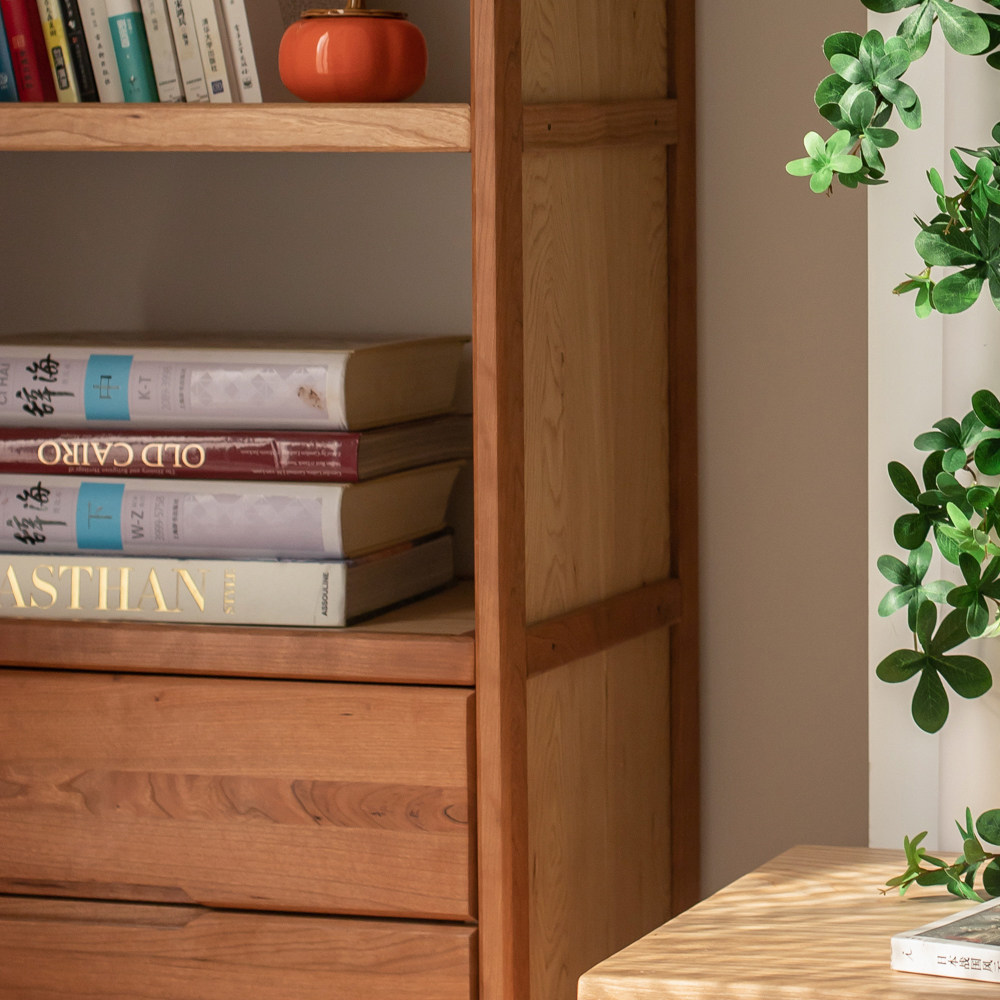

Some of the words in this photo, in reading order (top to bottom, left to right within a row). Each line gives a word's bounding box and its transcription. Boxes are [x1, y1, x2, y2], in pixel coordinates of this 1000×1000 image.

[92, 375, 120, 400] 中
[138, 375, 152, 401] K-T
[37, 440, 134, 467] CAIRO
[141, 443, 206, 469] OLD
[132, 510, 145, 539] W-Z
[223, 568, 237, 616] STYLE
[320, 571, 330, 617] ASSOULINE
